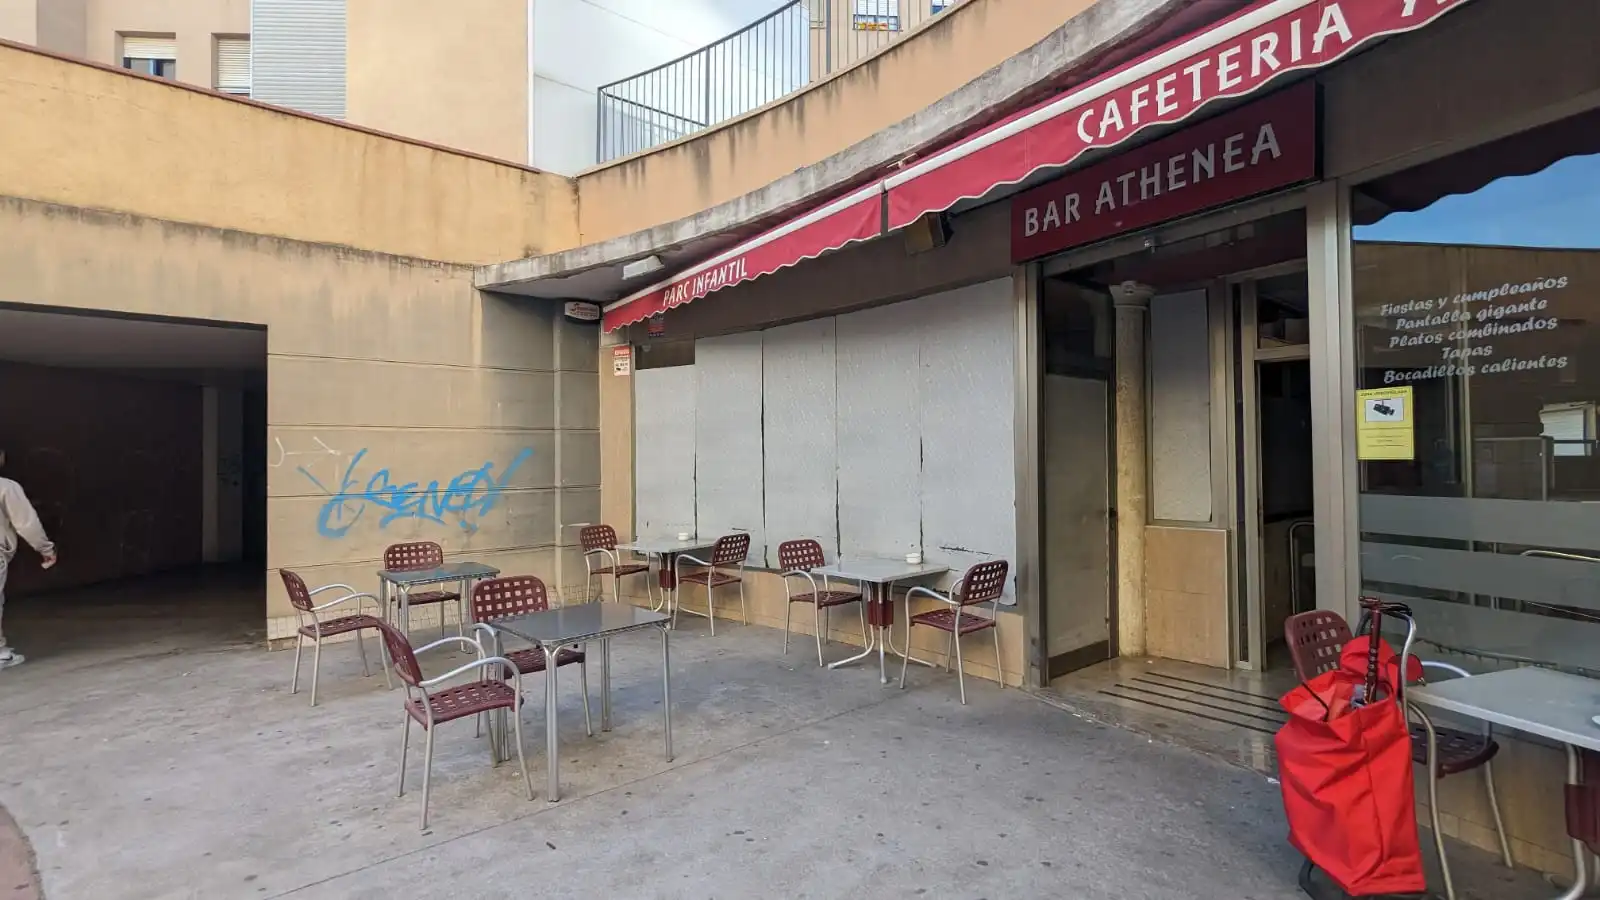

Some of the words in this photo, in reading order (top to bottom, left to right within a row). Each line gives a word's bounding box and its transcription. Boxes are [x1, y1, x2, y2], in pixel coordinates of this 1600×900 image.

[1076, 2, 1353, 144] CAFETERIA
[1024, 191, 1082, 237] BAR
[1094, 122, 1282, 215] ATHENEA
[663, 281, 691, 306] PARC
[692, 257, 748, 296] INFANTIL
[1380, 297, 1433, 317] Fiestas
[1437, 295, 1448, 310] y
[1452, 275, 1569, 305] cumpleaños
[1389, 331, 1443, 348] Platos
[1447, 315, 1558, 341] combinados
[1395, 310, 1471, 330] Pantalla
[1476, 297, 1548, 322] gigante
[1384, 362, 1476, 384] Bocadillos
[1481, 354, 1568, 375] calientes
[1441, 344, 1493, 360] Tapas
